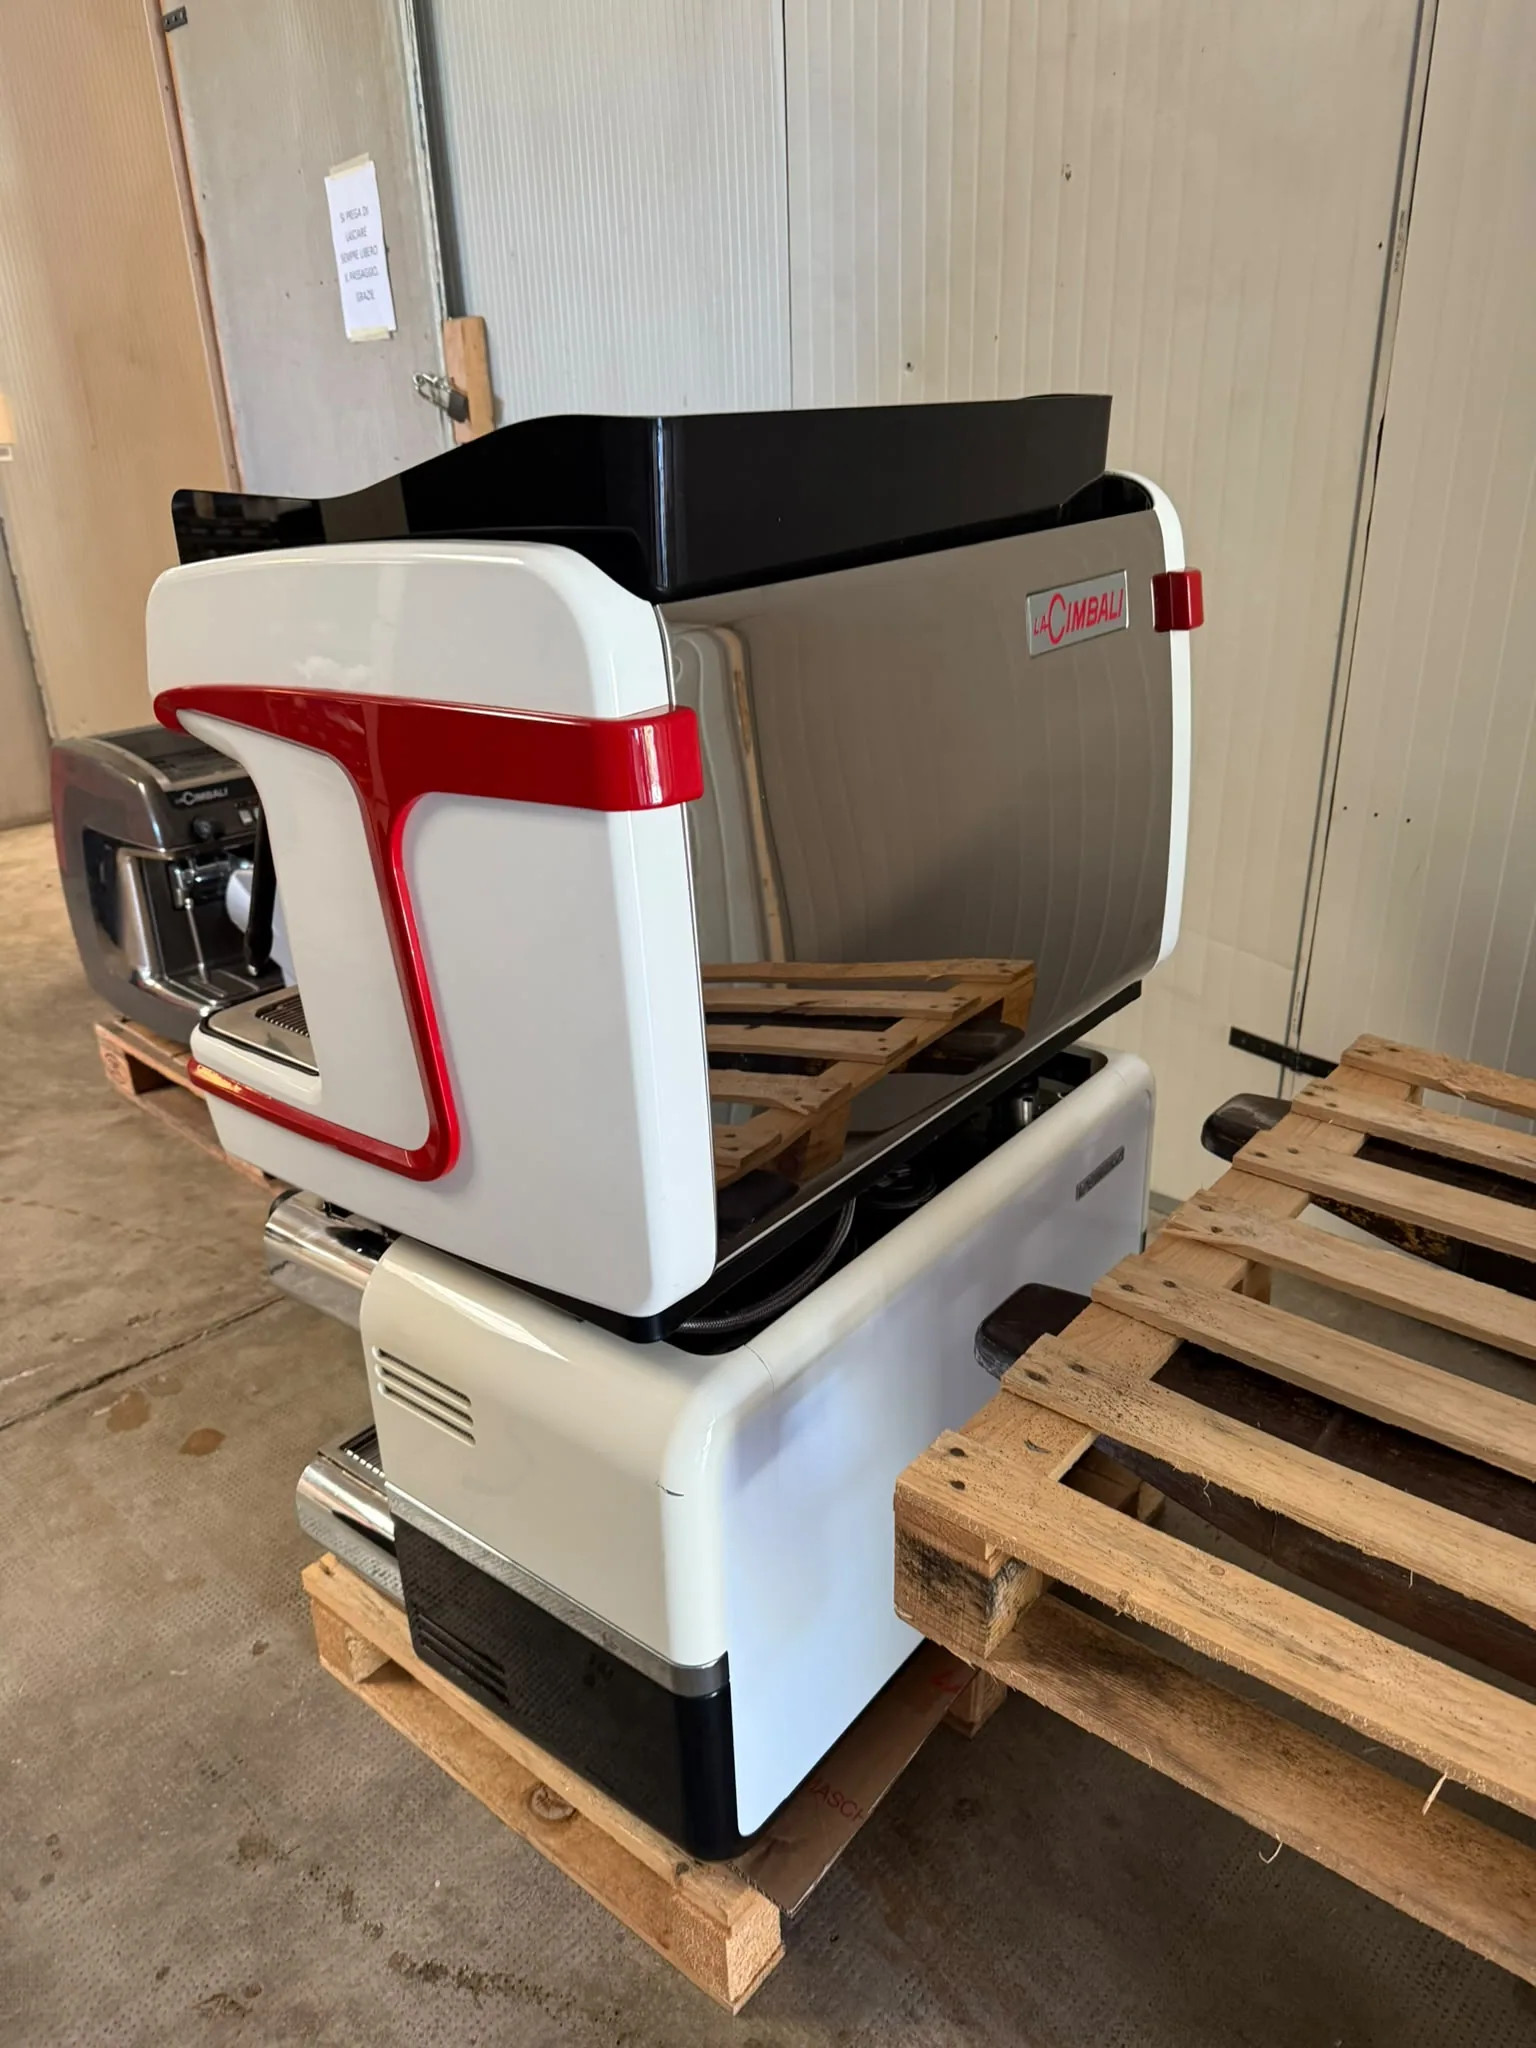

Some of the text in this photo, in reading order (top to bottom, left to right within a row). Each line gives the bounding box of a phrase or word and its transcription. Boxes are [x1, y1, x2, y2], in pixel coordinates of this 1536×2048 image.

[355, 288, 375, 302] GRAZIE
[1033, 589, 1124, 645] LA CIMBALI
[182, 787, 228, 805] CIMBALI
